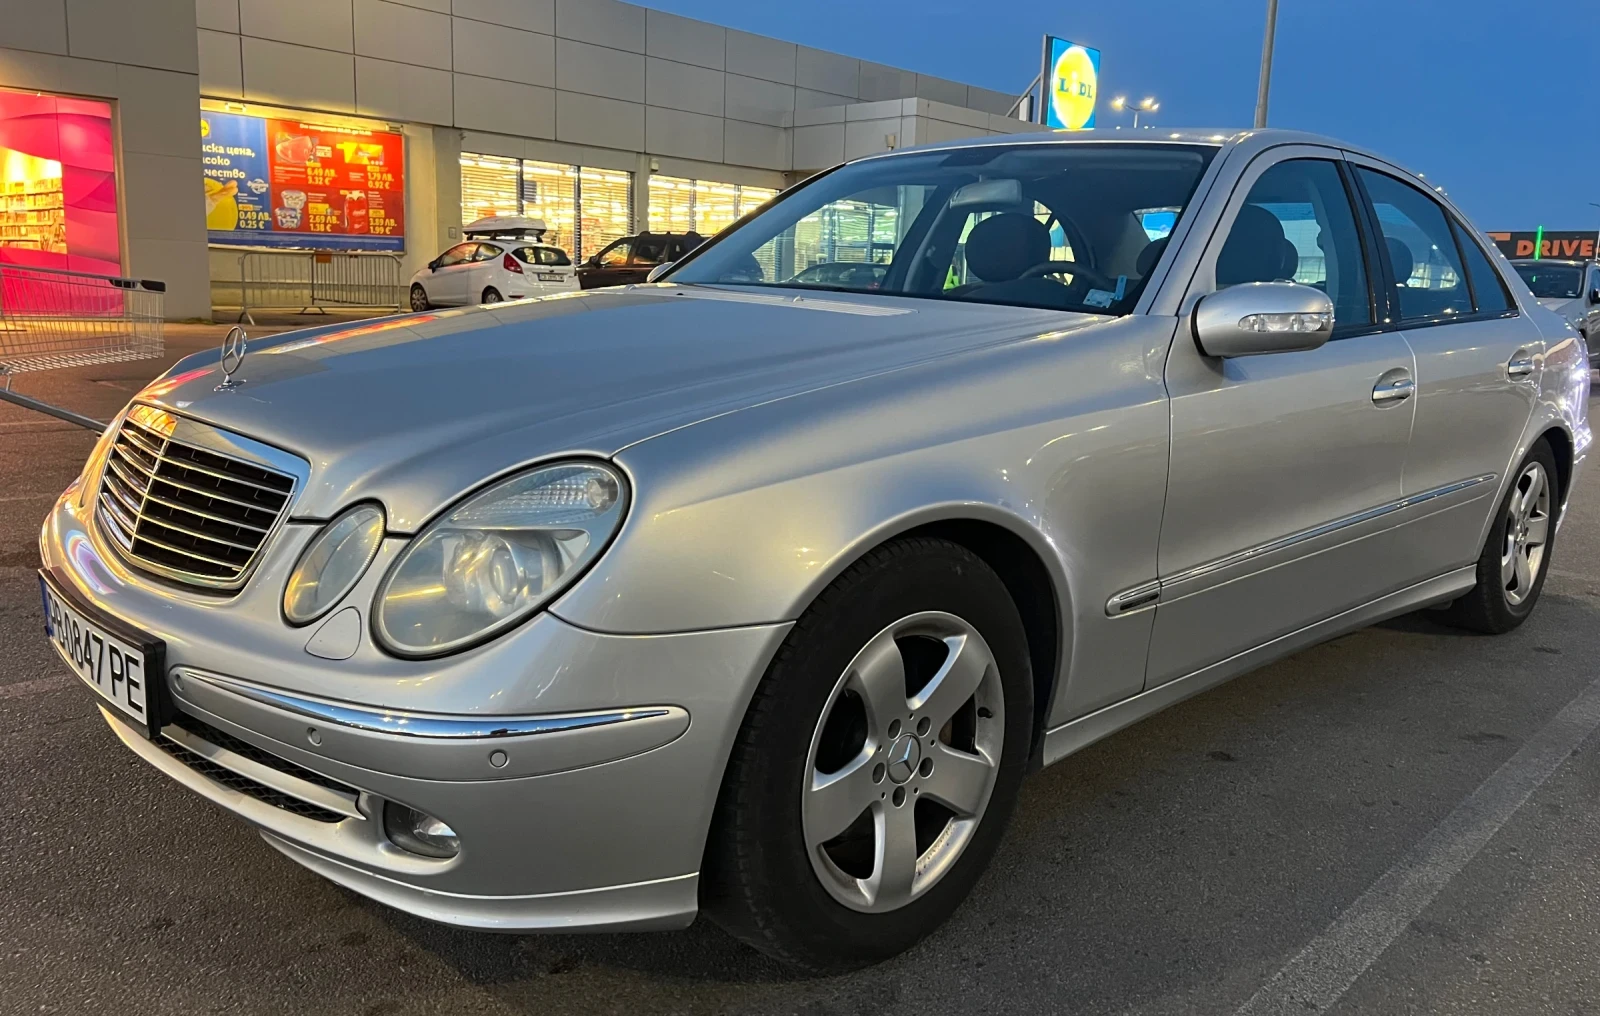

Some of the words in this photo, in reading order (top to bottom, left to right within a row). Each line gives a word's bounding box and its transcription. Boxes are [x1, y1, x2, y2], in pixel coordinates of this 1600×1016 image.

[367, 172, 381, 181] 1.79
[239, 211, 257, 220] 0.49
[239, 220, 257, 229] 0.25
[369, 226, 385, 235] 1.99
[1516, 239, 1594, 256] DRIVE
